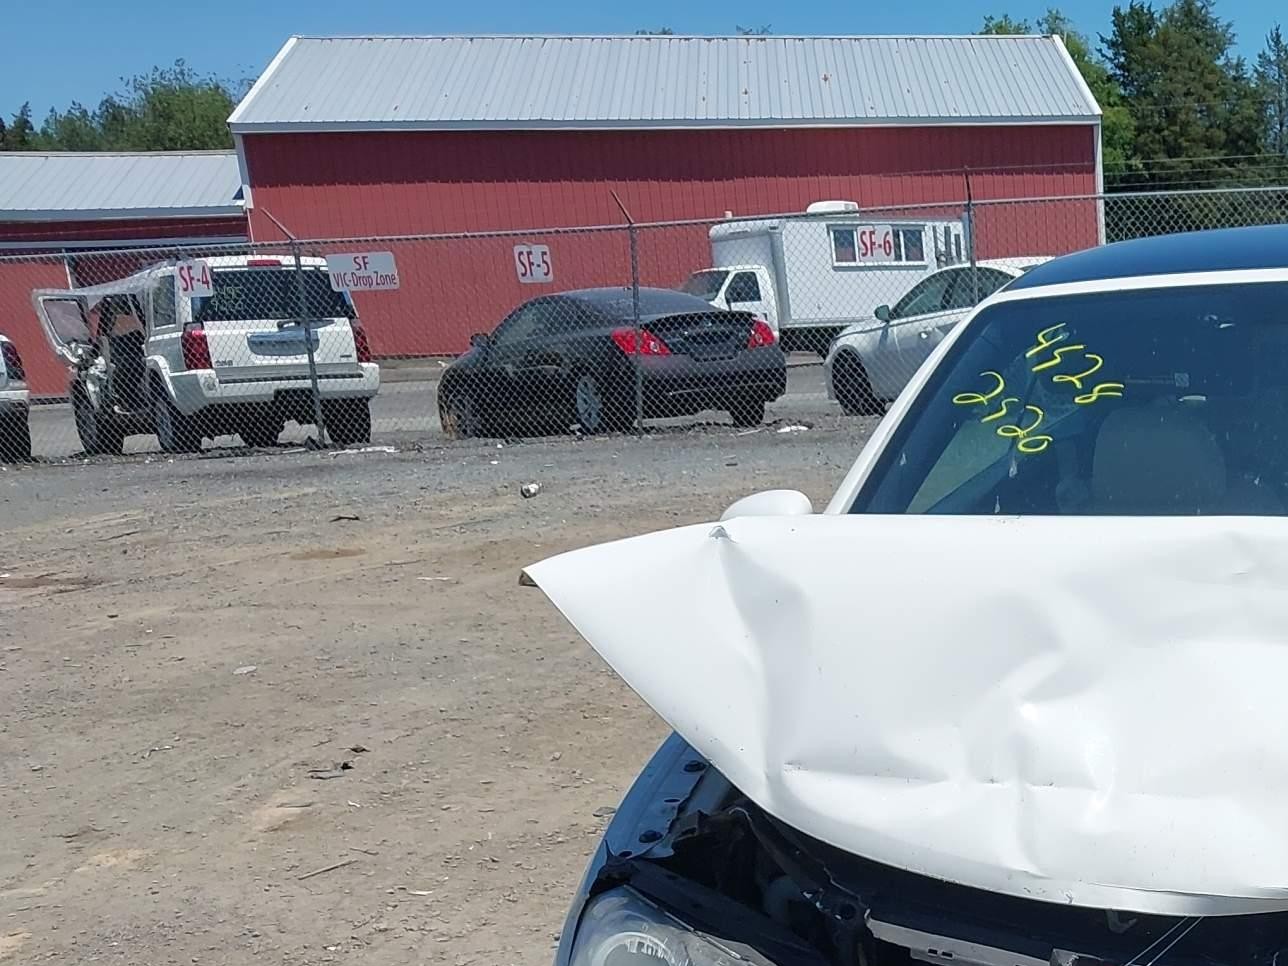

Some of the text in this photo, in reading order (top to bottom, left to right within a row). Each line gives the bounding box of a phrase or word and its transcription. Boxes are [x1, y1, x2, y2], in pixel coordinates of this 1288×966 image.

[859, 230, 893, 258] SF-6
[353, 256, 369, 271] SF
[515, 251, 551, 278] SF-5
[178, 266, 210, 292] SF-4
[333, 271, 397, 288] VIC-Drop Zone
[1024, 322, 1126, 404] 4528
[952, 371, 1053, 453] 2520
